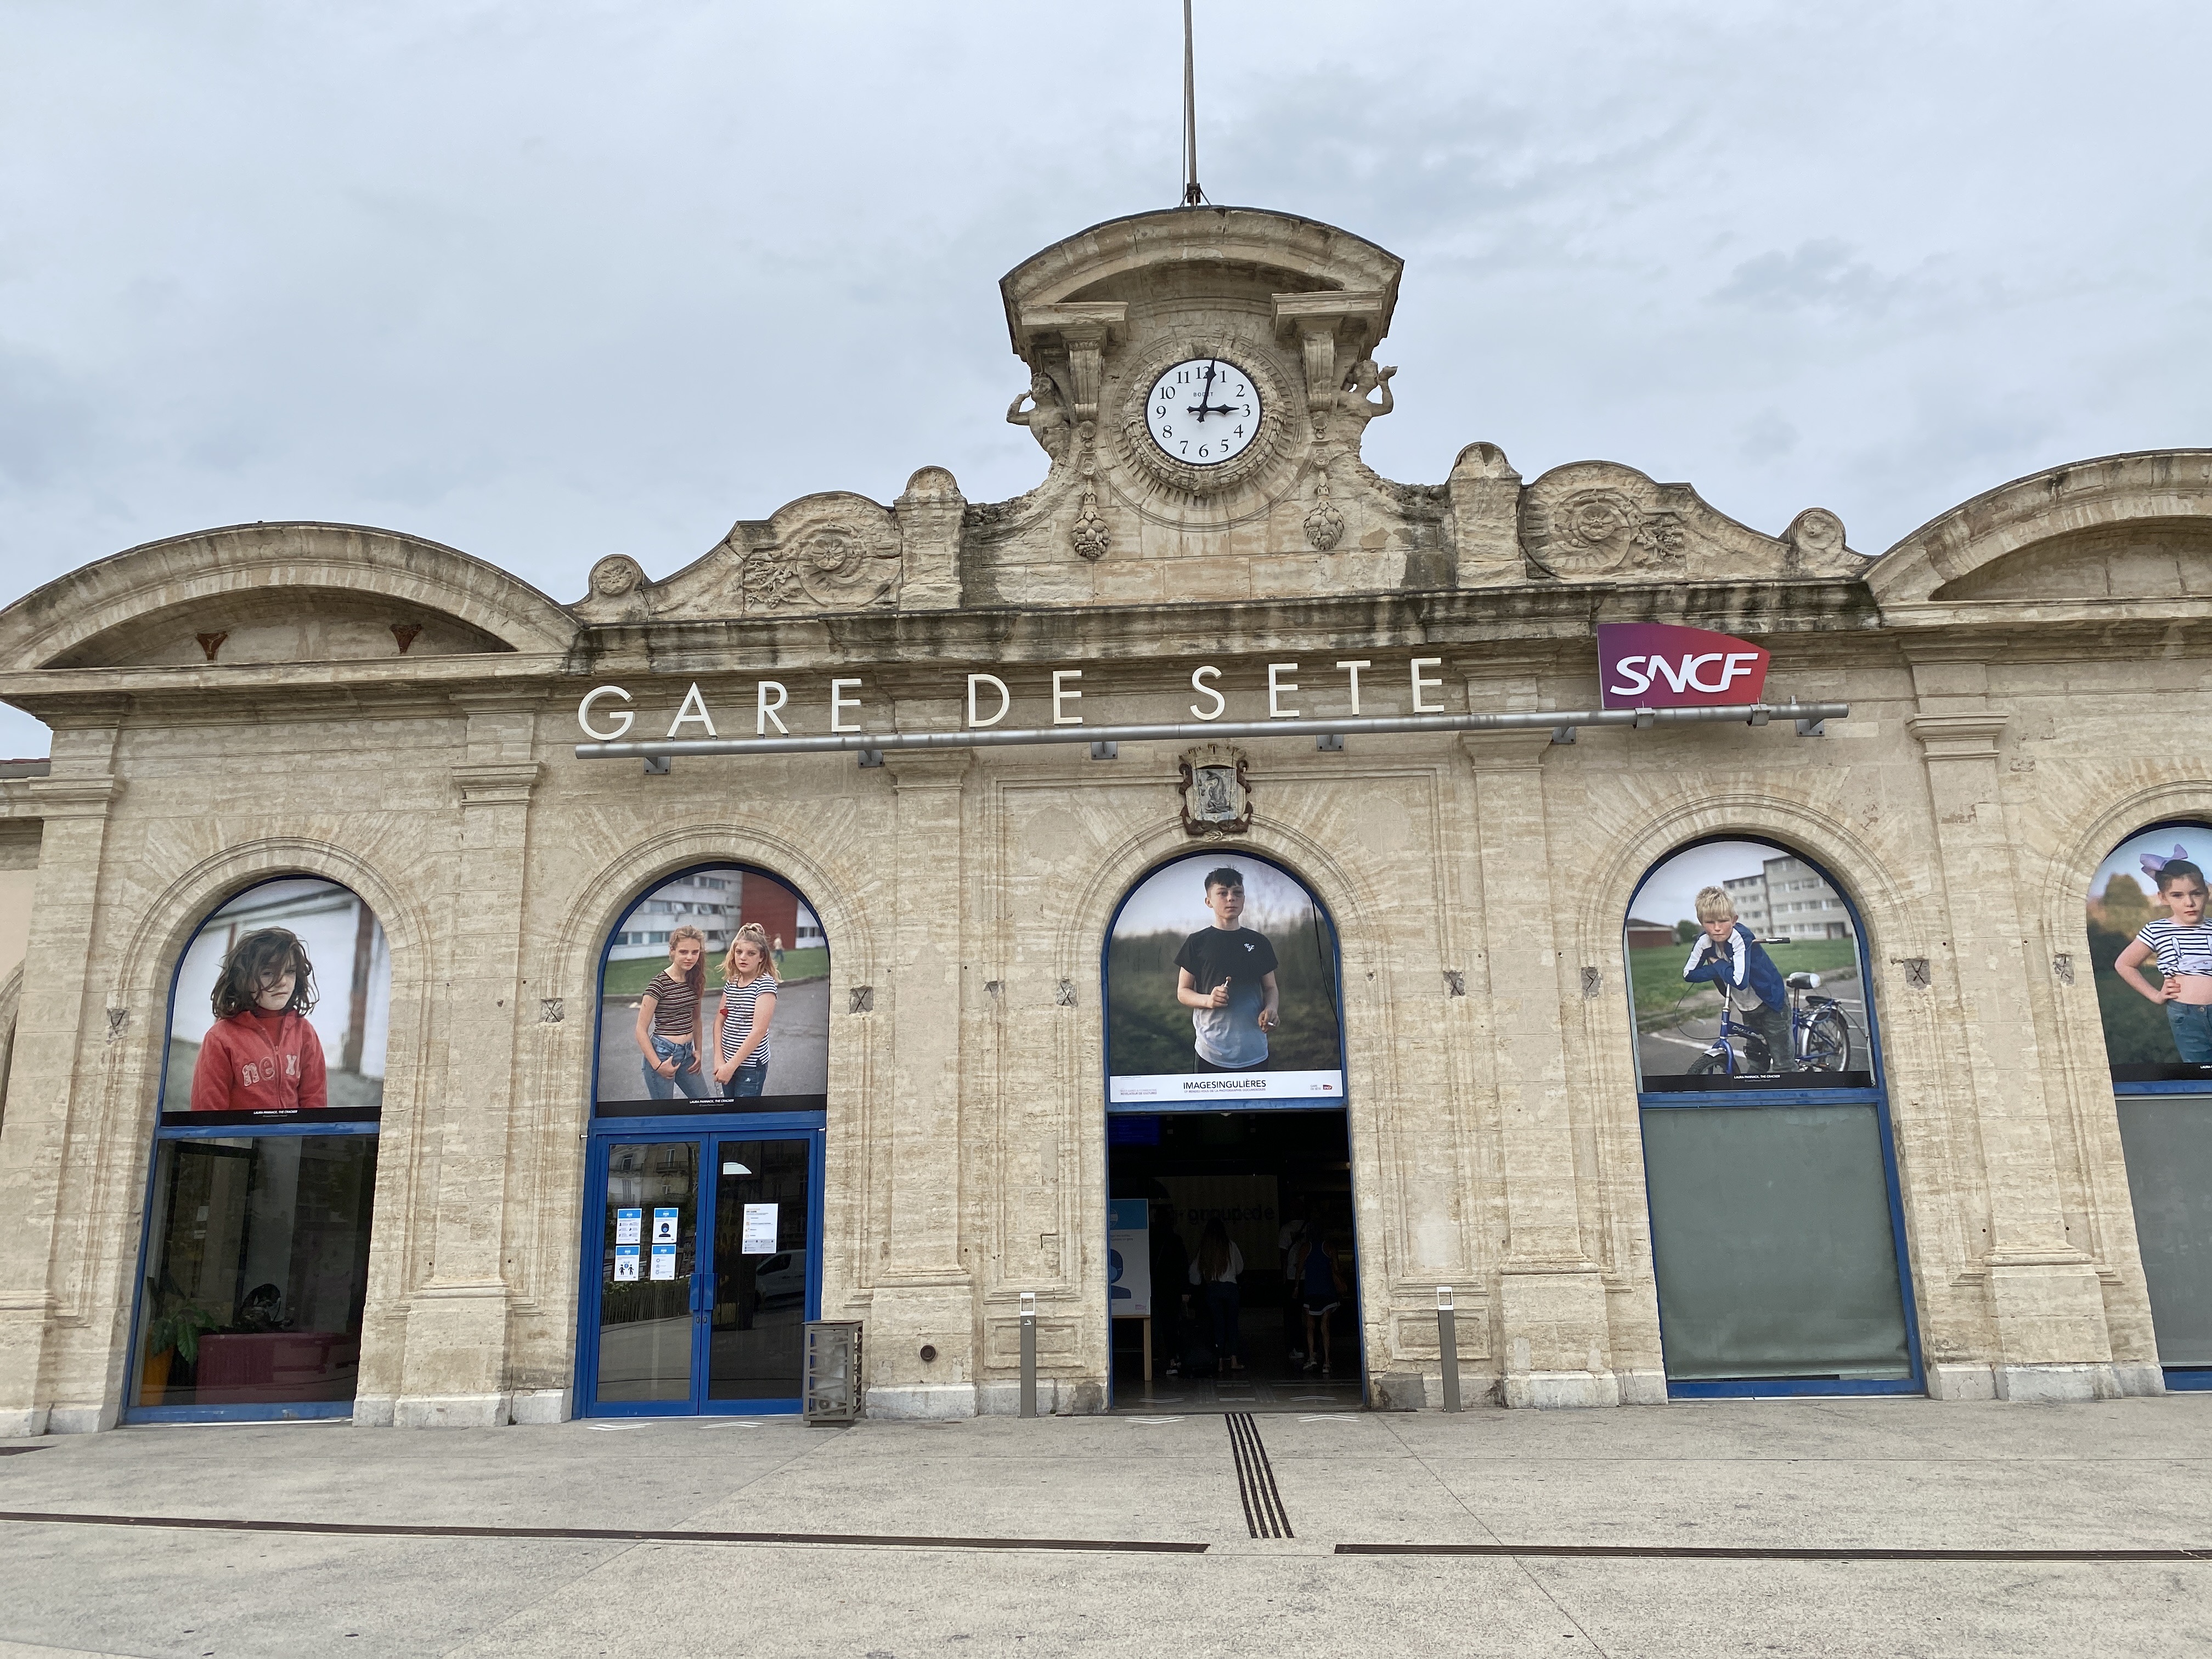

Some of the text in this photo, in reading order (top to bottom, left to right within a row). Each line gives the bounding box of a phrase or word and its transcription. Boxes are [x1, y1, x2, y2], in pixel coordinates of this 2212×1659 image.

[1176, 371, 1190, 383] 11
[1220, 370, 1227, 383] 1
[1160, 386, 1176, 399] 10
[1235, 385, 1245, 397] 2
[1156, 406, 1166, 419] 9
[1242, 404, 1251, 417] 3
[1162, 425, 1172, 438] 8
[1233, 424, 1244, 438] 4
[1180, 441, 1188, 454] 7
[1198, 444, 1209, 458] 6
[1220, 439, 1229, 453] 5
[1610, 652, 1759, 696] SNCF
[577, 657, 1444, 741] GARE DE SETE
[1183, 1079, 1266, 1090] IMAGESINGULIÈRES
